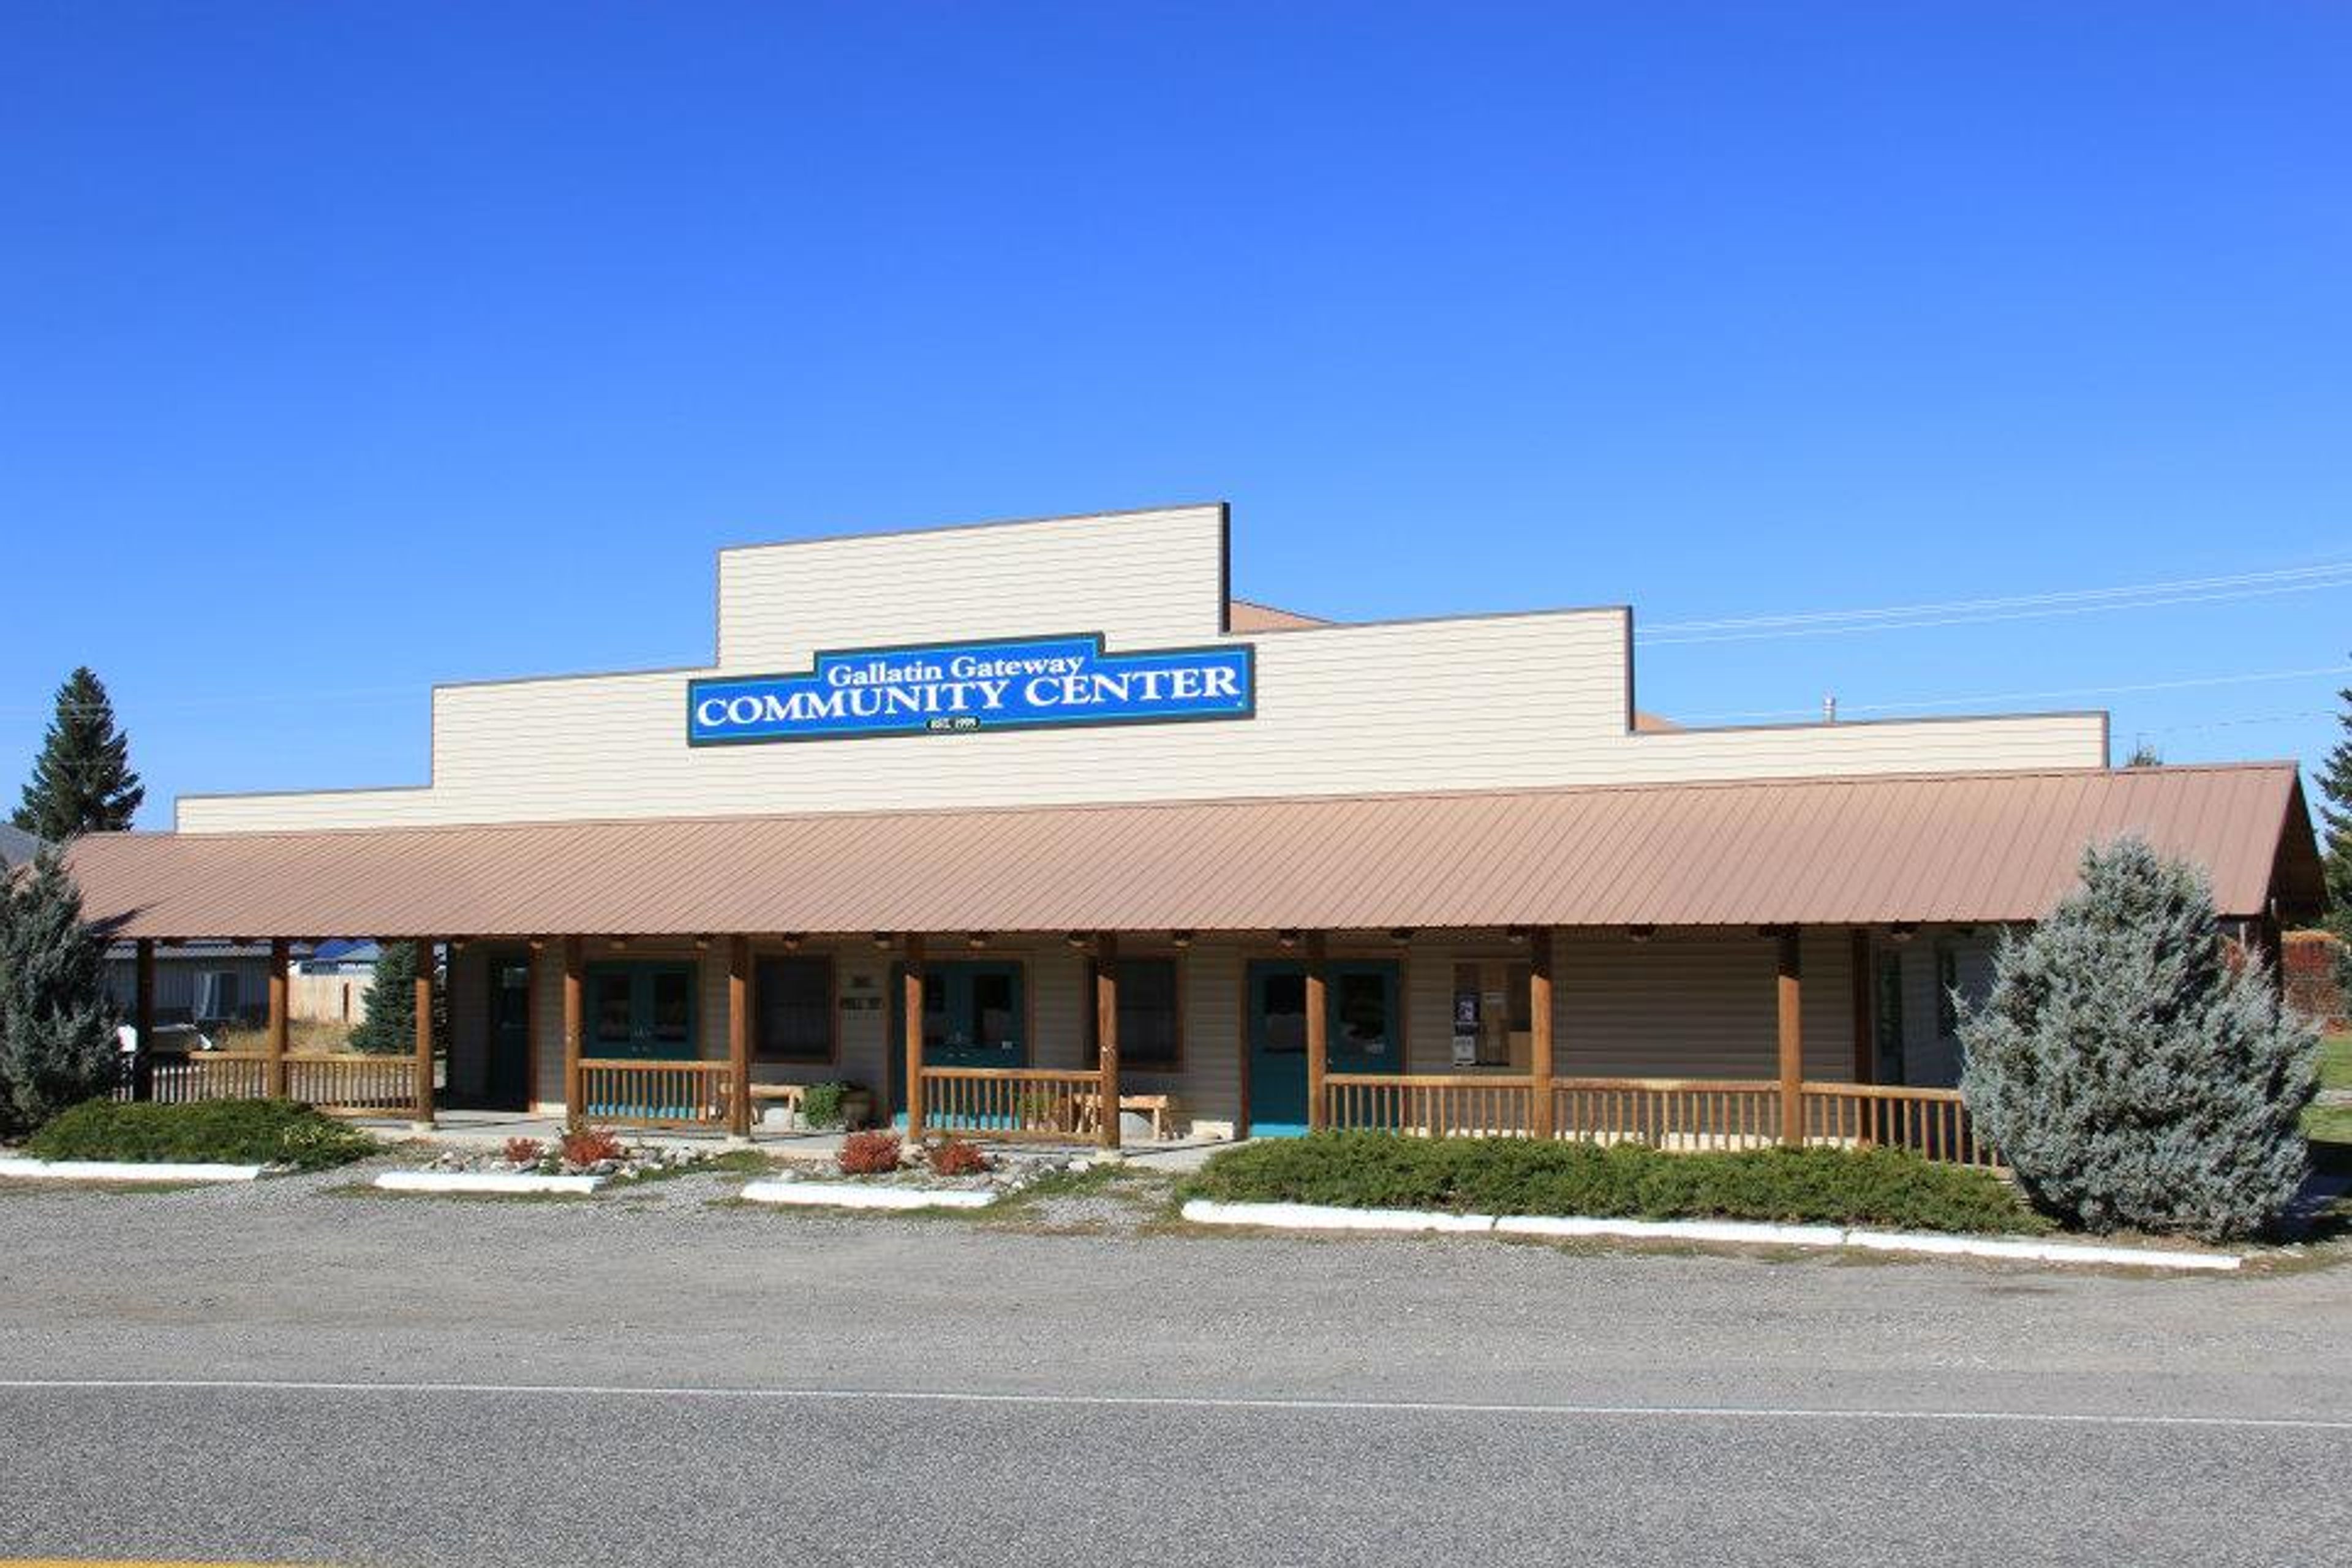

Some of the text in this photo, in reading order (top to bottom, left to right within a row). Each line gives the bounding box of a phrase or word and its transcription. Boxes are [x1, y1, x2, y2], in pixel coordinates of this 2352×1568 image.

[828, 656, 1085, 687] Gallatin Gateway
[698, 666, 1240, 726] COMMUNITY CENTER
